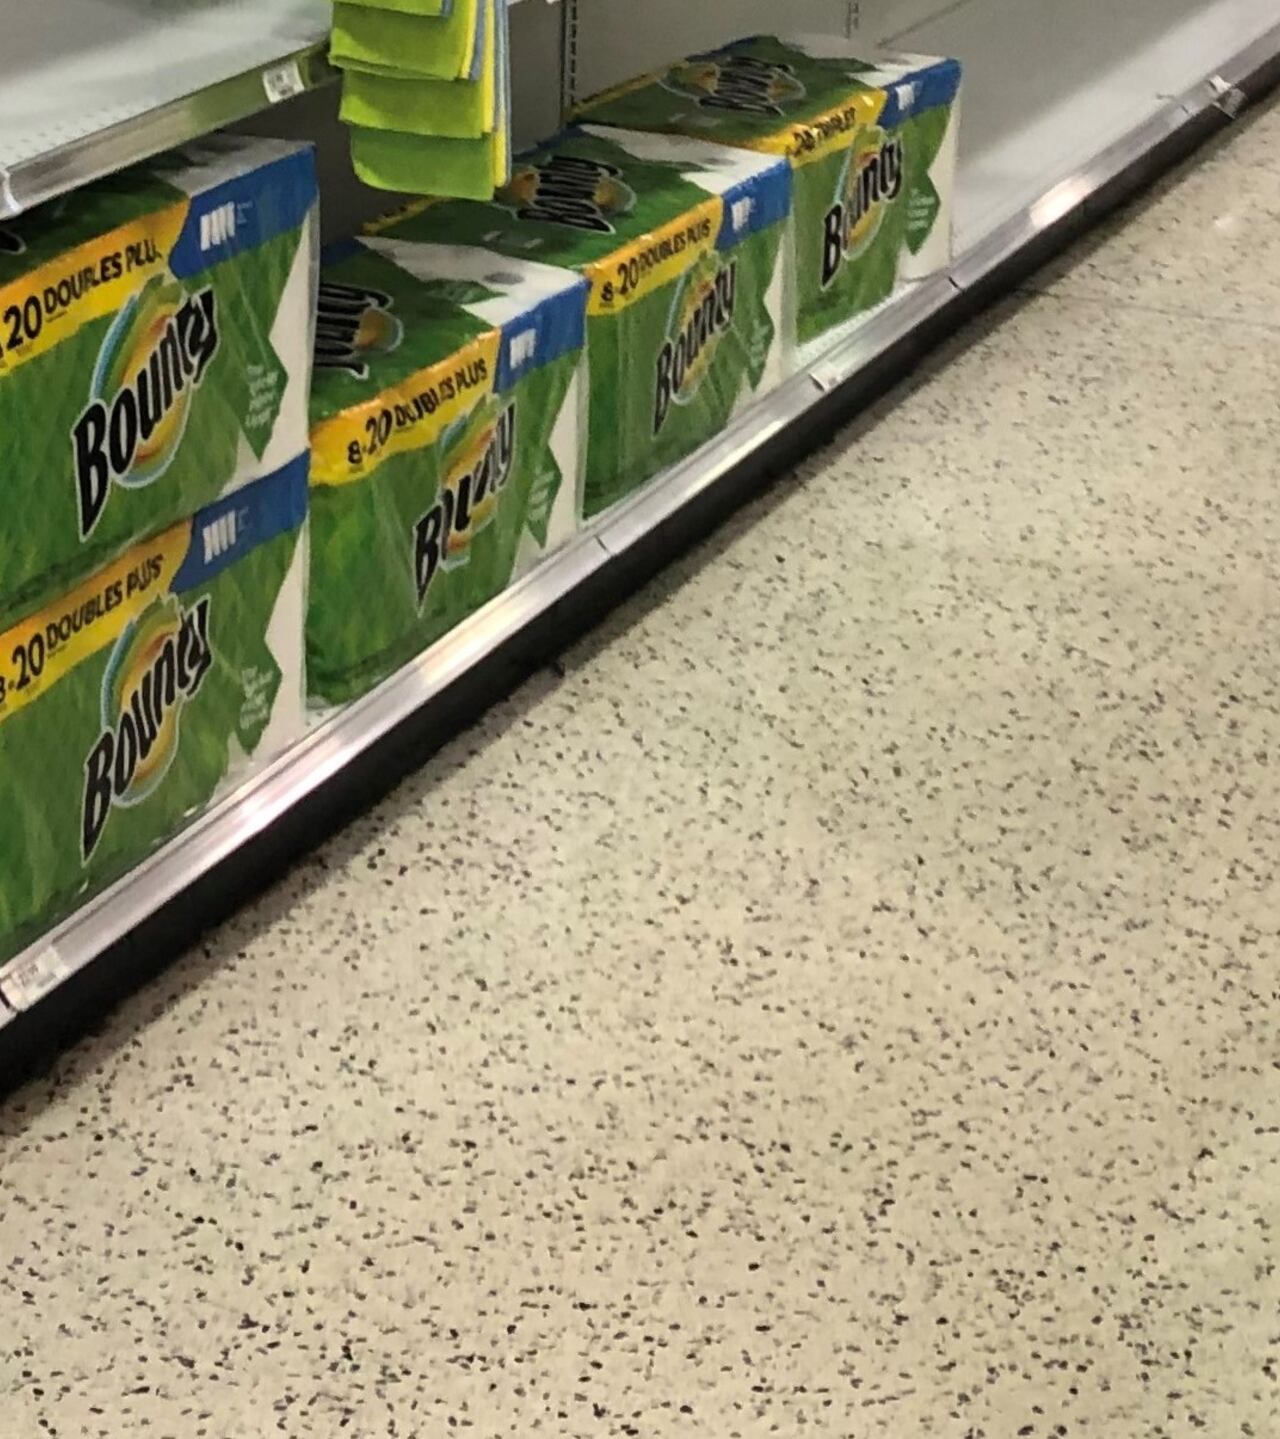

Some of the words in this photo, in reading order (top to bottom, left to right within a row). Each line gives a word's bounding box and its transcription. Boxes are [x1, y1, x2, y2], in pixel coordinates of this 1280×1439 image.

[3, 295, 42, 351] 20
[618, 257, 639, 295] 20
[654, 260, 736, 434] Bounty
[72, 289, 217, 540] Bounty
[348, 440, 363, 465] 8
[365, 409, 393, 455] 20
[455, 358, 487, 393] PLUS
[13, 633, 45, 691] 20
[45, 580, 123, 651] DOUBLES
[81, 601, 213, 866] Bounty
